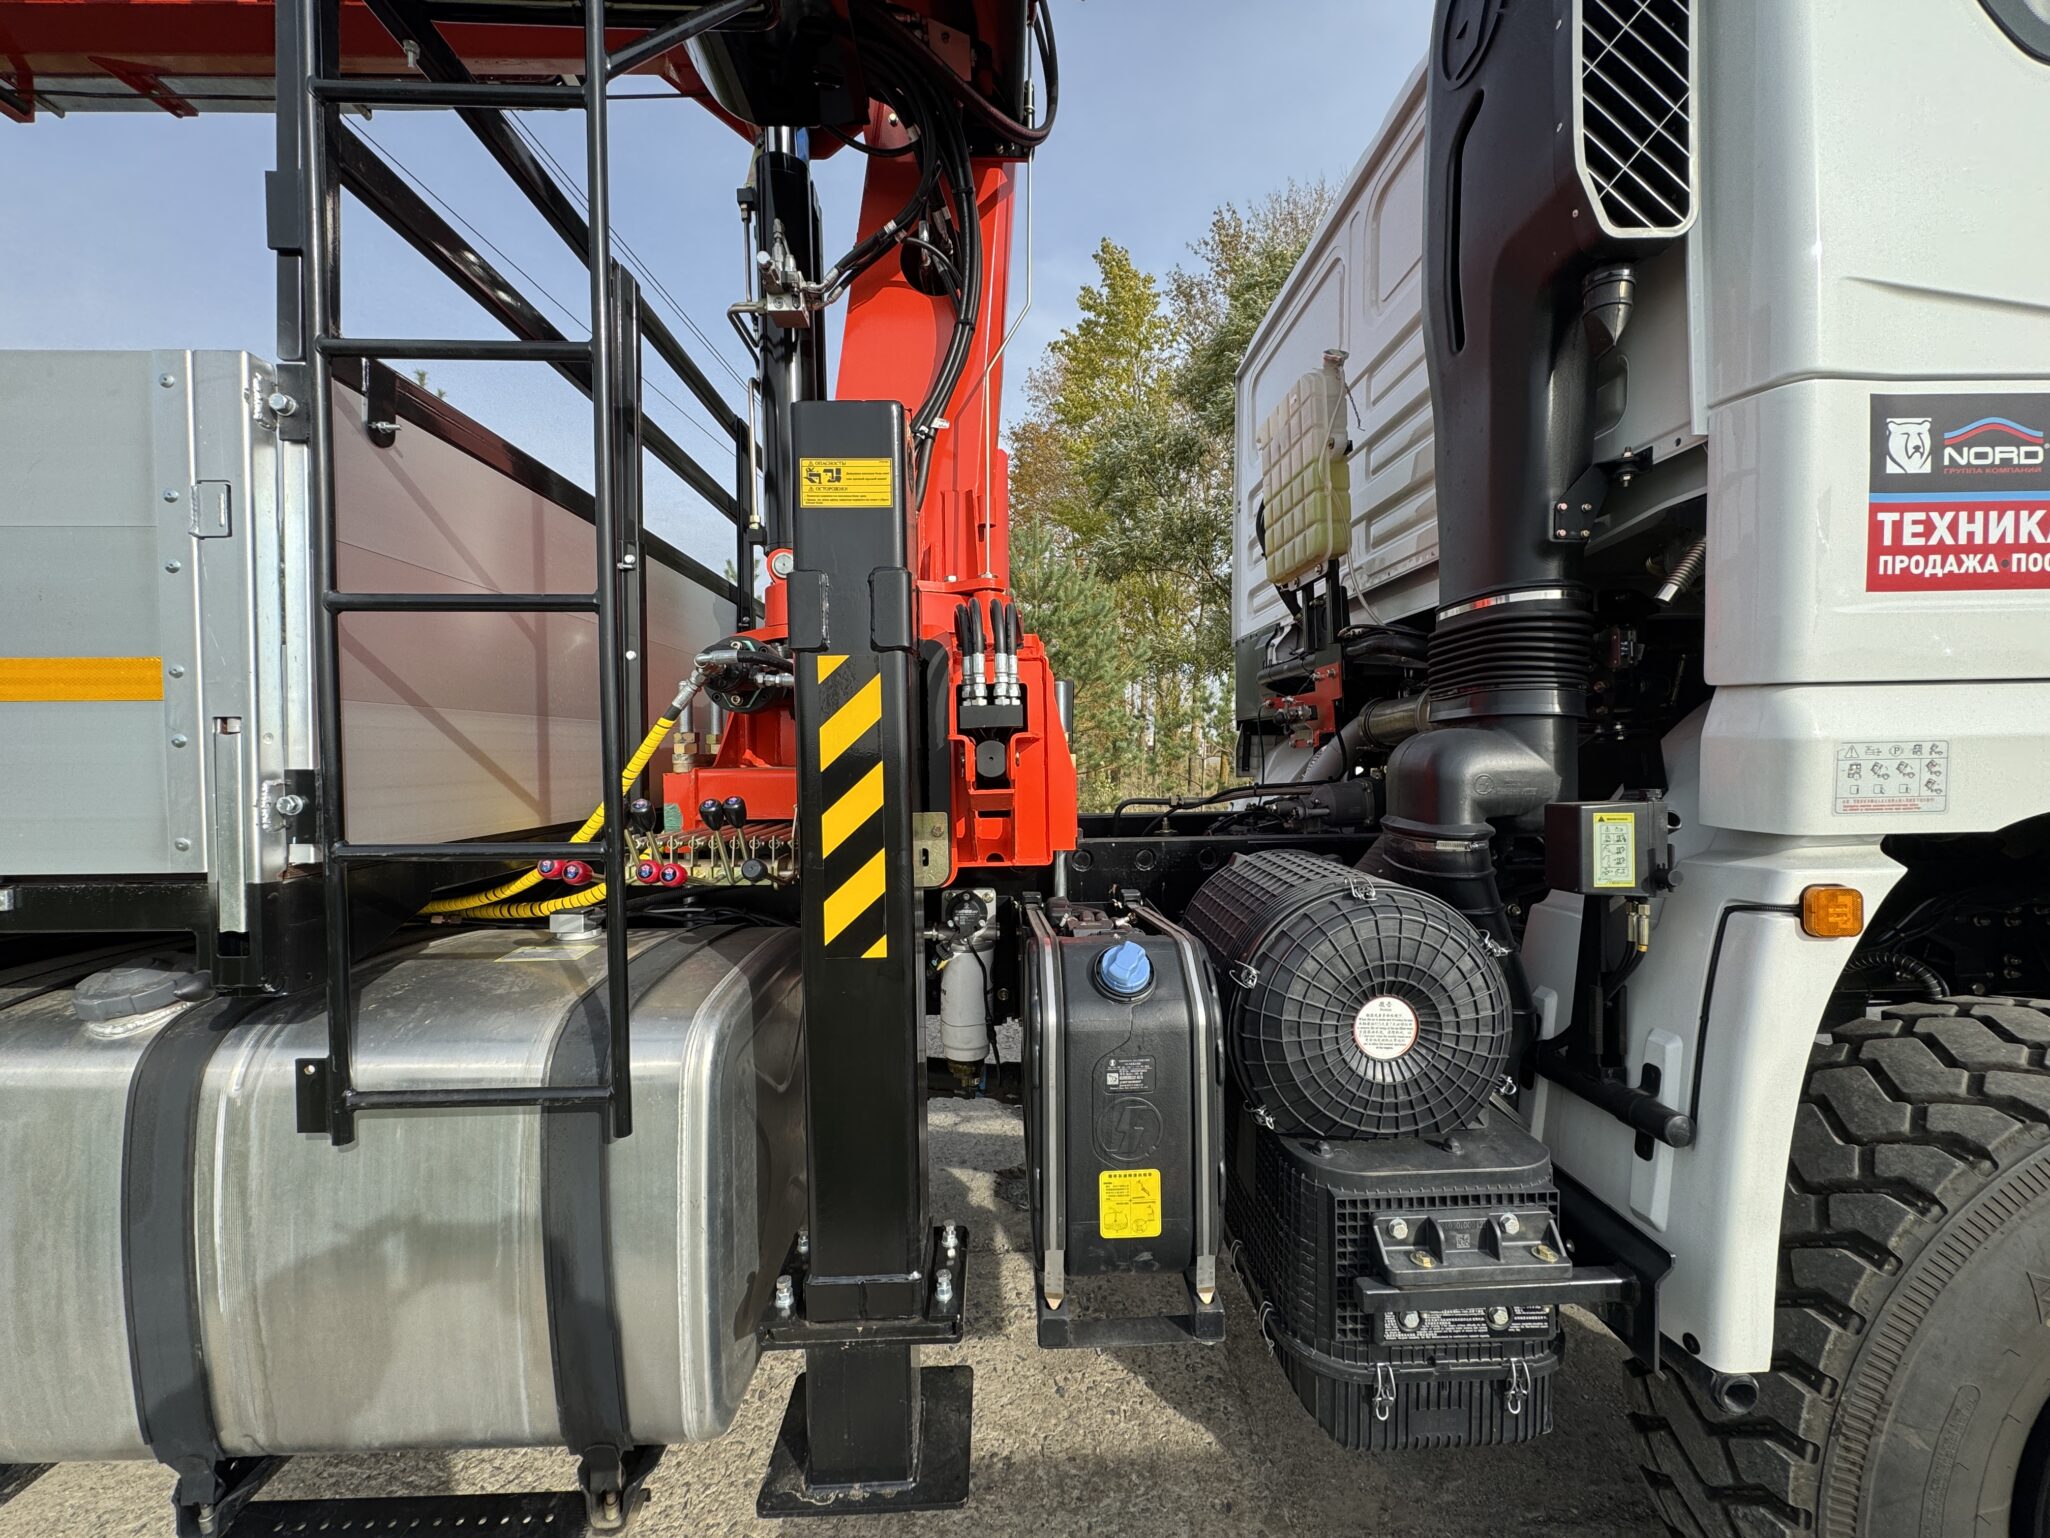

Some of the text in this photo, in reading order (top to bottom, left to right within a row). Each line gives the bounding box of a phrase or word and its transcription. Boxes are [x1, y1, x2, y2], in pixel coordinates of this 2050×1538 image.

[1943, 446, 2044, 466] NORD
[1877, 510, 2050, 546] ТЕХНИК
[1878, 554, 1999, 577] ПРОДАЖА
